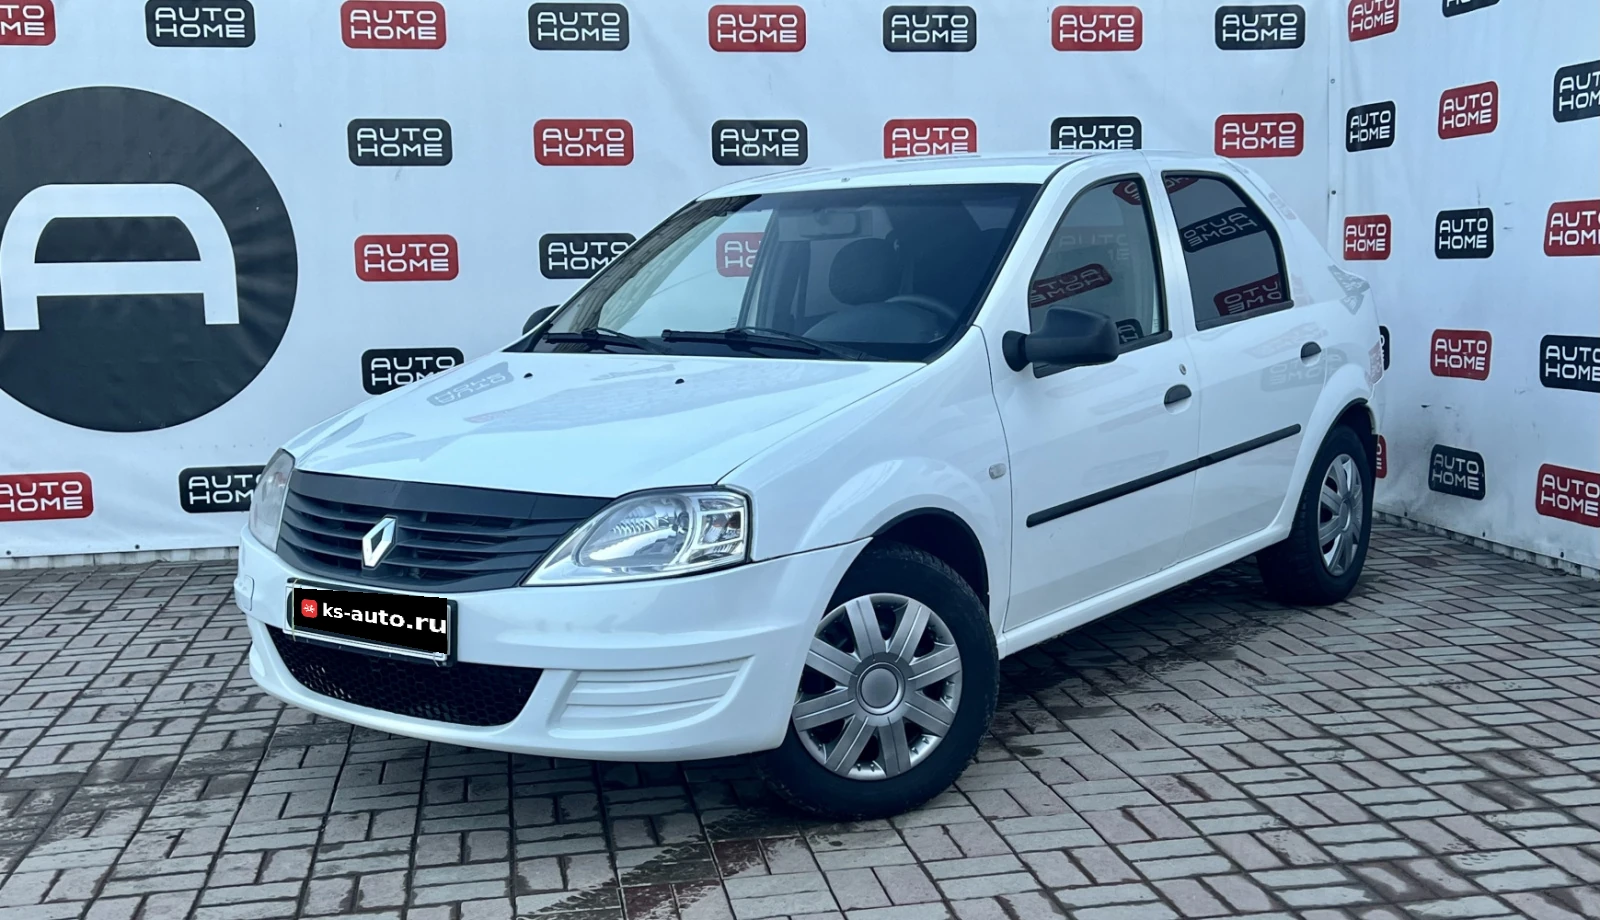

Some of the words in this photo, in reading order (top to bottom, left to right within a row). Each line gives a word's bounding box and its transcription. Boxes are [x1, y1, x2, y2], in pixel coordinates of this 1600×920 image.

[154, 7, 246, 22] AUTO
[350, 9, 437, 24] AUTO
[1352, 0, 1395, 18] AUTO
[537, 11, 621, 26] AUTO
[717, 13, 798, 28] AUTO
[891, 14, 969, 28] AUTO
[1059, 14, 1135, 28] AUTO
[1222, 12, 1298, 27] AUTO
[1351, 10, 1394, 33] HOME
[155, 23, 246, 38] HOME
[350, 25, 437, 40] HOME
[537, 27, 620, 42] HOME
[717, 29, 797, 43] HOME
[891, 29, 968, 43] HOME
[1059, 29, 1134, 43] HOME
[1222, 27, 1297, 42] HOME
[1443, 91, 1493, 113] AUTO
[1350, 109, 1391, 129] AUTO
[1442, 108, 1492, 130] HOME
[356, 127, 443, 142] AUTO
[542, 128, 625, 142] AUTO
[720, 128, 800, 142] AUTO
[891, 127, 969, 141] AUTO
[1058, 124, 1135, 139] AUTO
[1222, 121, 1297, 136] AUTO
[1350, 125, 1390, 144] HOME
[357, 143, 443, 157] HOME
[542, 143, 625, 157] HOME
[720, 143, 799, 157] HOME
[892, 142, 968, 155] HOME
[1059, 140, 1133, 150] HOME
[1222, 135, 1296, 150] HOME
[1440, 217, 1488, 234] AUTO
[1550, 210, 1600, 228] AUT
[1346, 223, 1386, 237] AUTO
[1549, 229, 1600, 246] HOM
[548, 242, 628, 255] AUTO
[1345, 238, 1385, 252] HOME
[1439, 234, 1487, 250] HOME
[363, 243, 450, 258] AUTO
[364, 258, 450, 273] HOME
[1435, 338, 1487, 354] AUTO
[371, 356, 455, 370] AUTO
[1435, 354, 1485, 371] HOME
[1434, 453, 1479, 474] AUTO
[188, 474, 261, 489] AUT
[1432, 469, 1479, 491] HOME
[1542, 473, 1600, 498] AUTO
[1541, 491, 1598, 517] HOME
